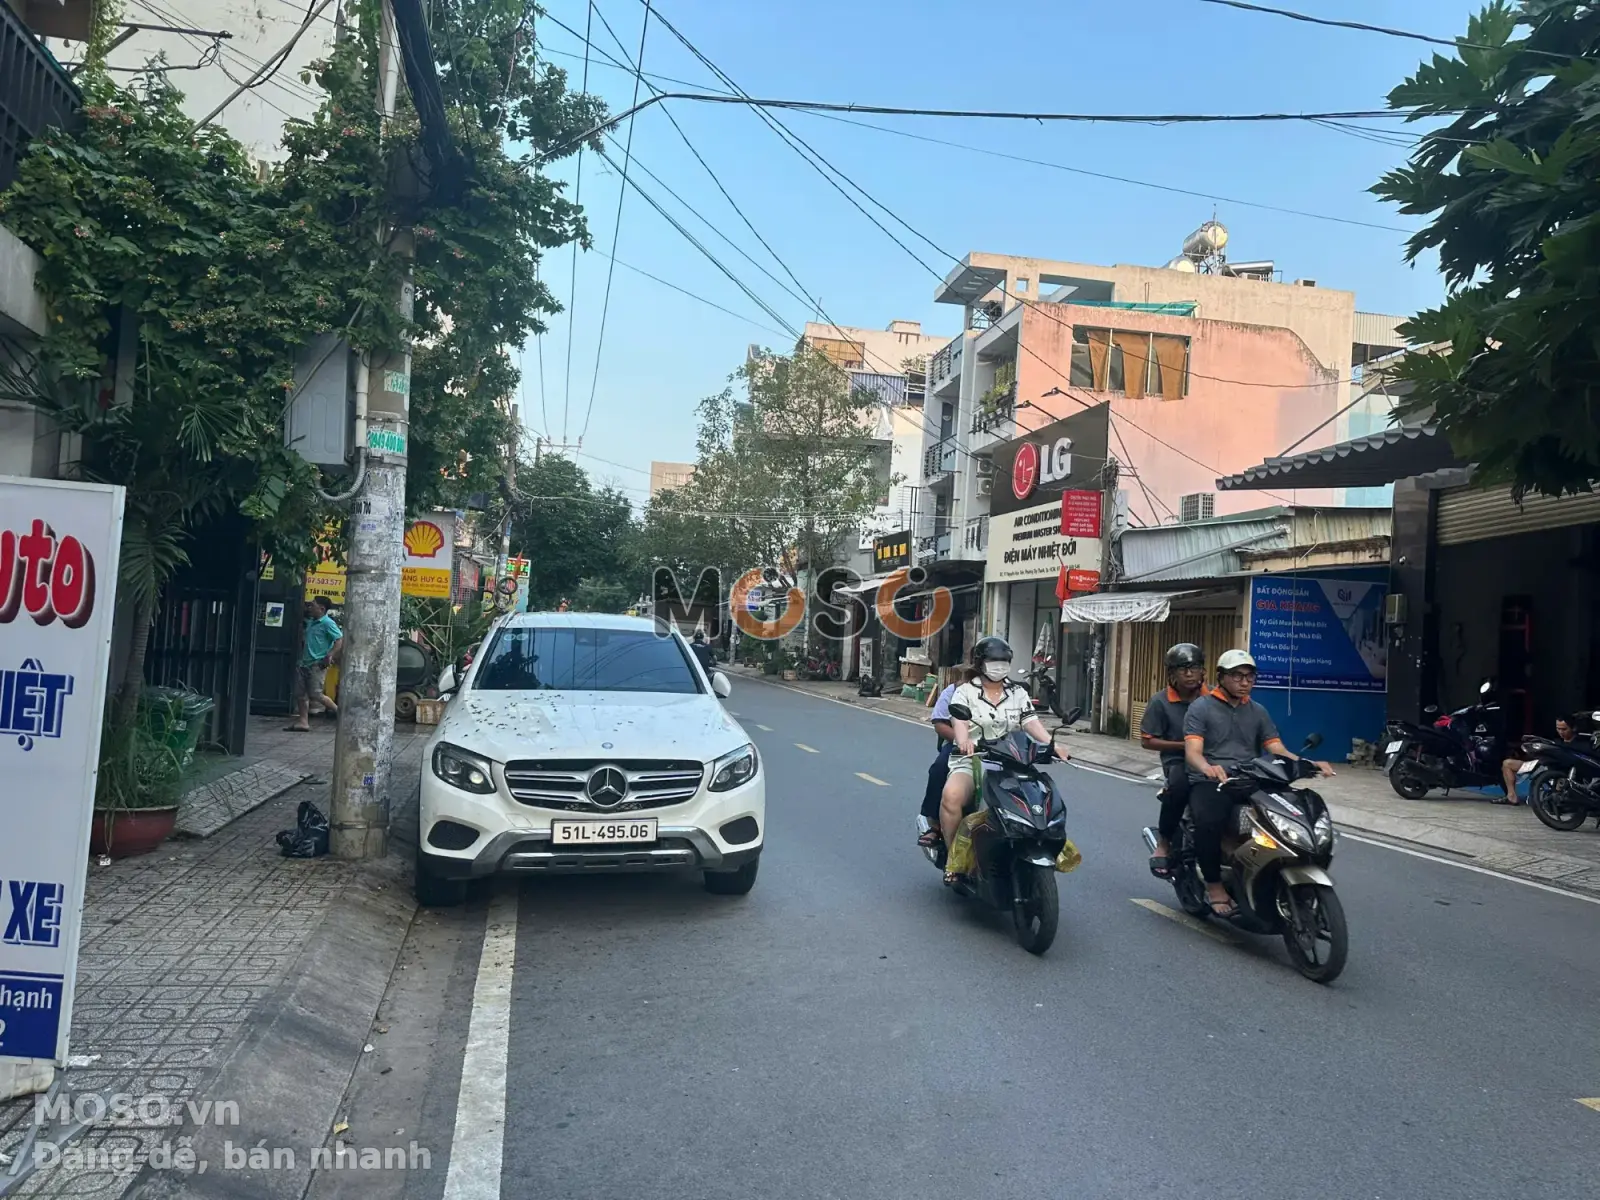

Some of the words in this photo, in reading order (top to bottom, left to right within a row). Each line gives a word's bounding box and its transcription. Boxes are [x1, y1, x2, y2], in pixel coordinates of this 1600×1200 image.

[1040, 437, 1073, 484] LG
[1014, 516, 1024, 527] AIR
[1004, 548, 1020, 565] ĐIỆN
[1021, 545, 1038, 561] MÁY
[1038, 541, 1061, 559] NHIỆT
[1061, 538, 1077, 556] ĐỚI
[1257, 585, 1270, 594] BẤT
[1272, 587, 1293, 596] ĐỘNG
[1256, 600, 1277, 611] GIA
[3, 880, 64, 948] XE
